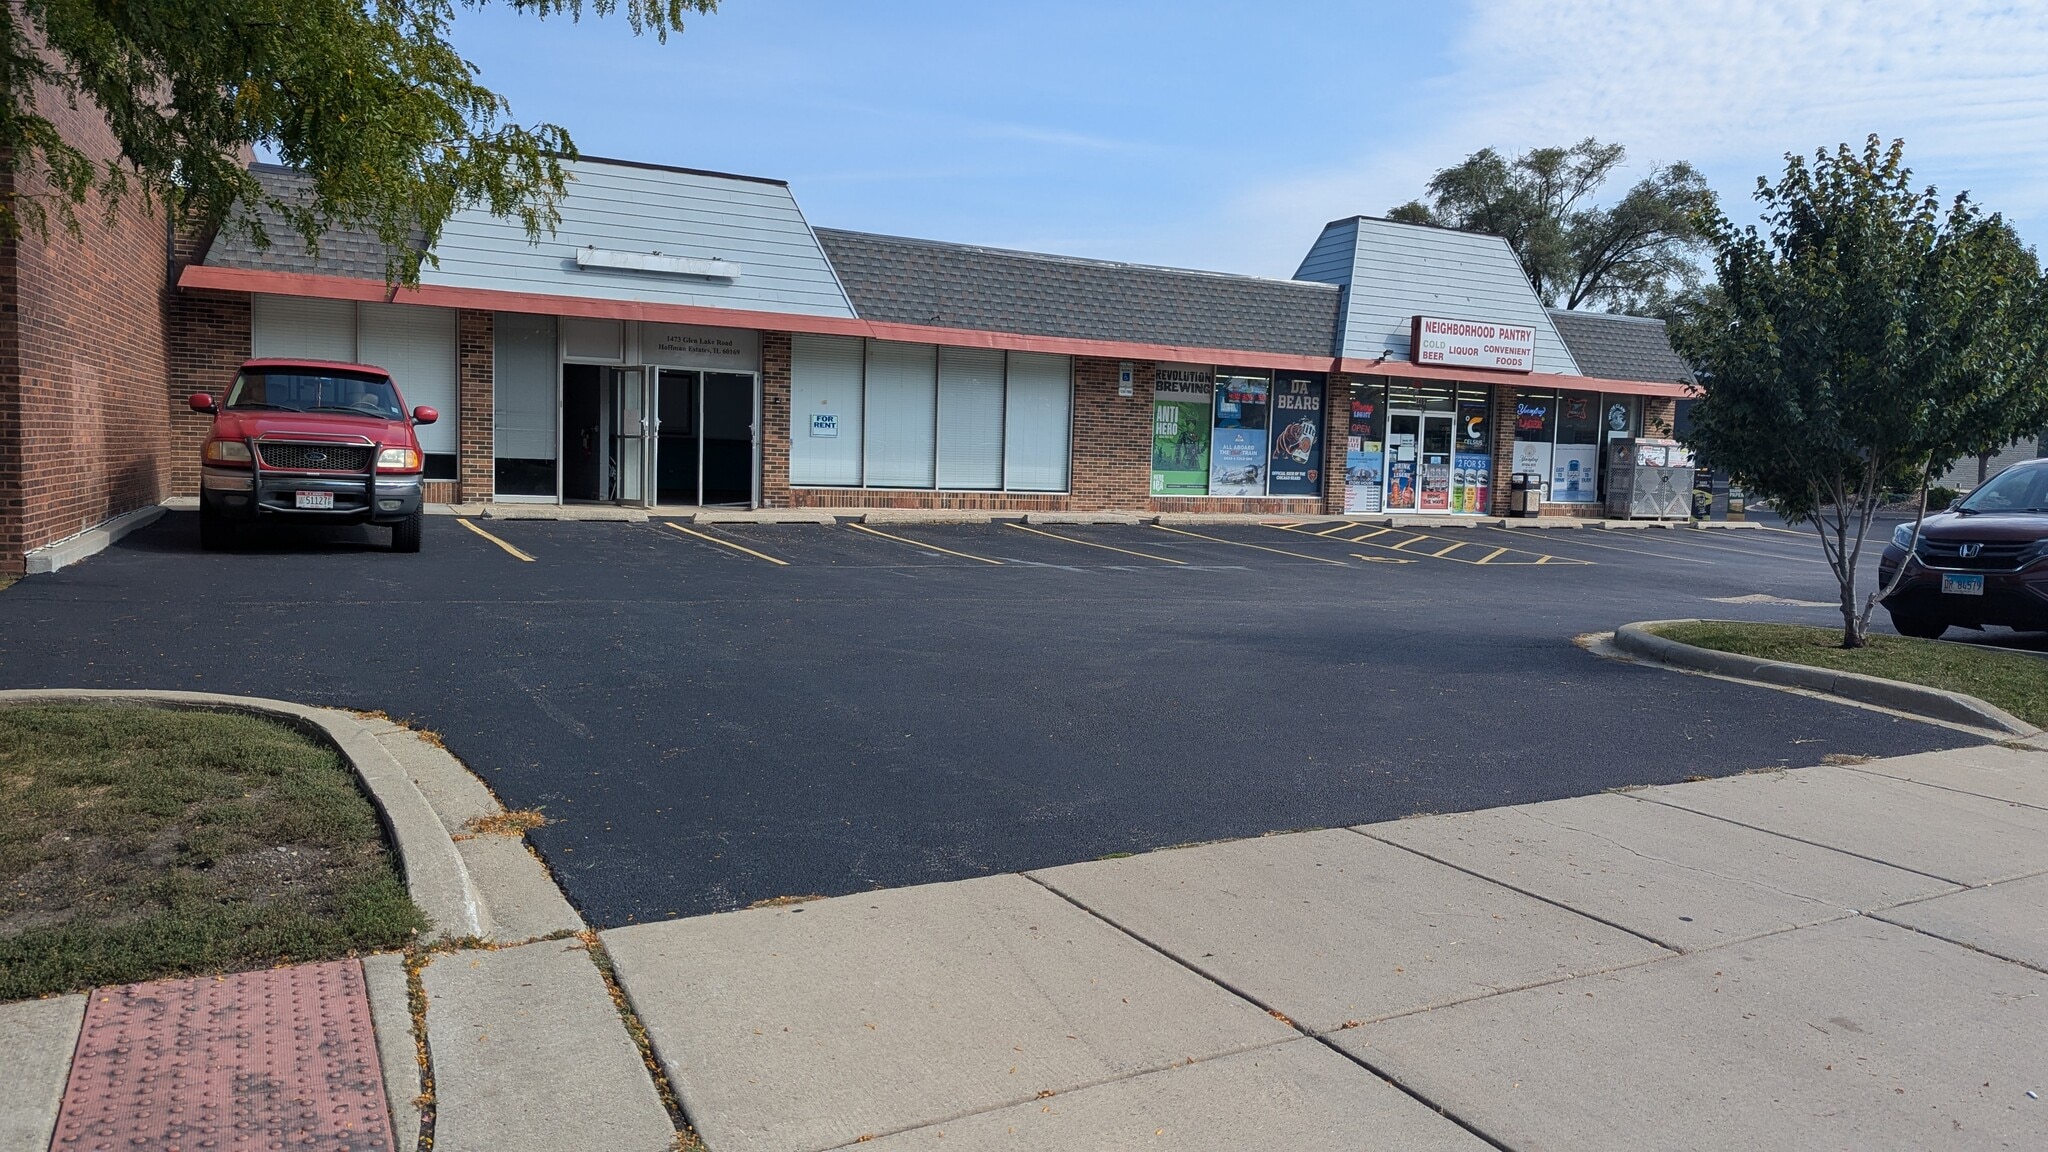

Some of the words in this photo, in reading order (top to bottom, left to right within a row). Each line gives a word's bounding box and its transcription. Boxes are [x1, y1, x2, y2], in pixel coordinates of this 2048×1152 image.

[1425, 321, 1495, 338] NEIGHBORHOOD
[1499, 328, 1532, 342] PANTRY
[658, 344, 686, 352] Hoffman
[1423, 339, 1446, 349] COLD
[1422, 351, 1444, 360] BEER
[1449, 346, 1479, 356] LIQUOR
[1483, 345, 1531, 356] CONVENIENT
[1496, 357, 1522, 366] FOODS
[1156, 370, 1211, 382] REVOLUTION
[1156, 381, 1211, 394] BREWING
[1291, 380, 1308, 394] DA
[1278, 394, 1320, 410] BEARS
[1156, 406, 1179, 422] ANTI
[1156, 422, 1178, 436] HERO
[1352, 424, 1371, 433] OPEN
[1458, 460, 1463, 468] 2
[1464, 460, 1476, 468] FOR
[1477, 460, 1486, 468] $5
[306, 496, 328, 505] 51127
